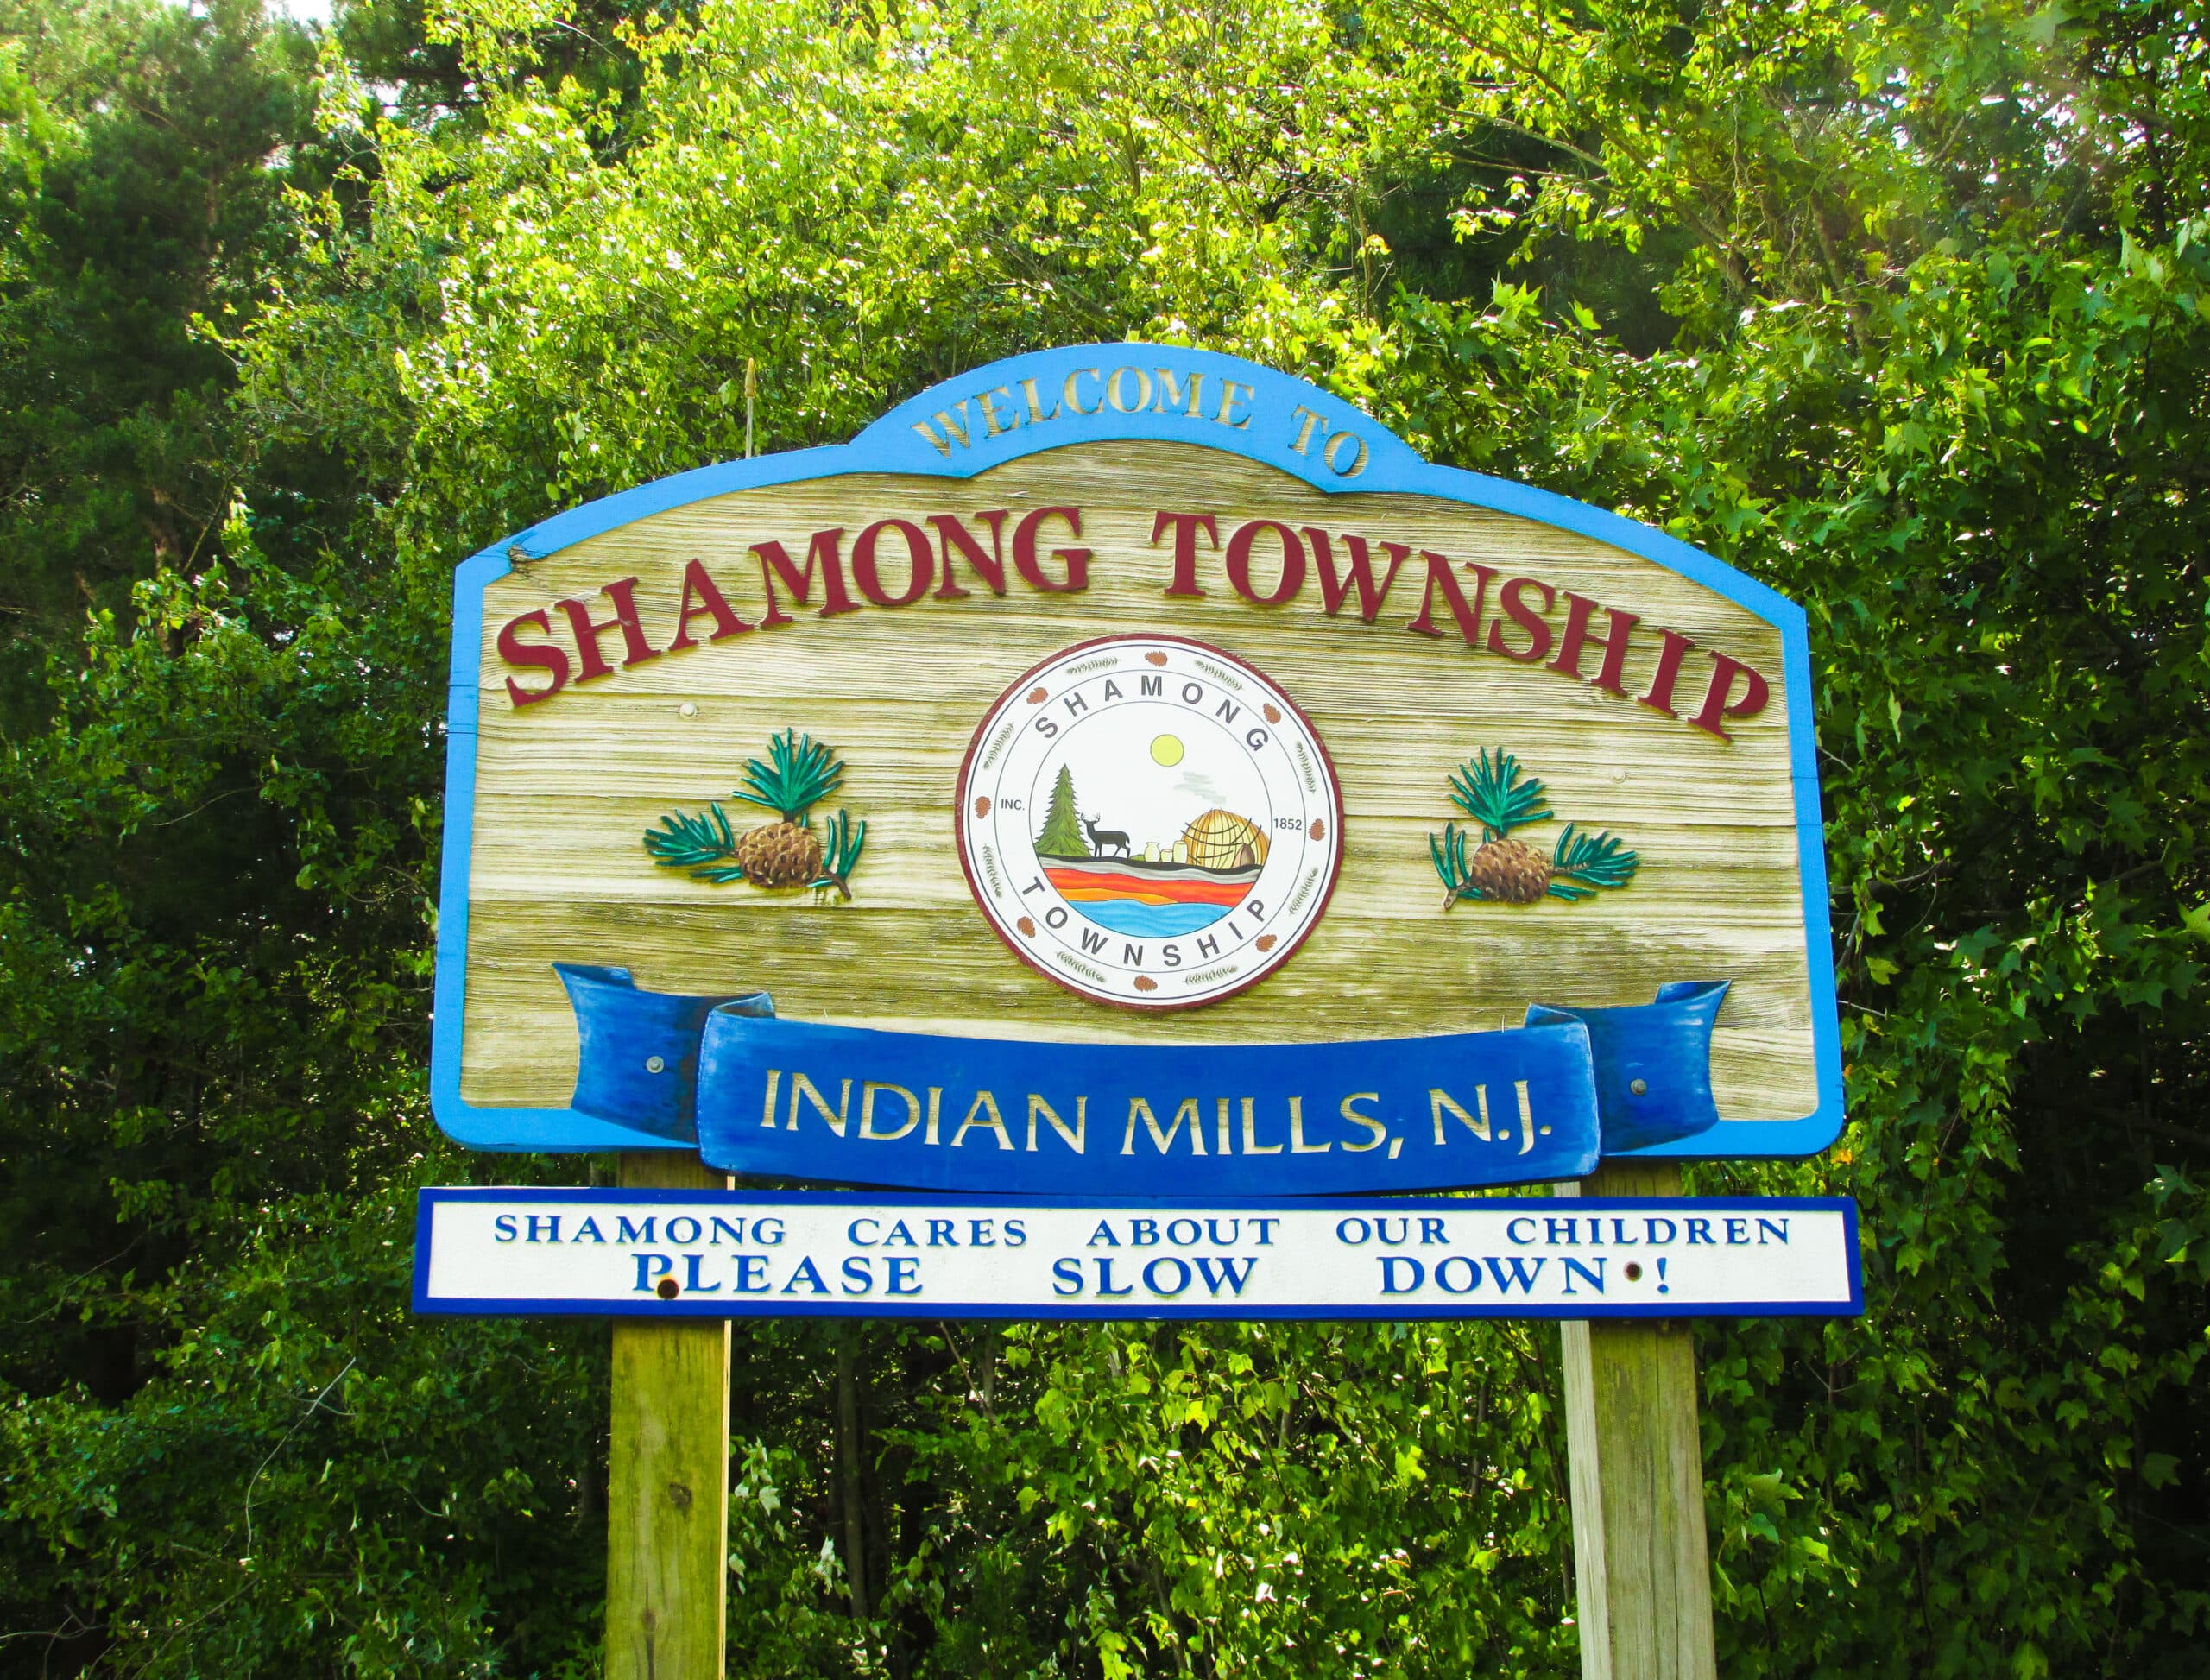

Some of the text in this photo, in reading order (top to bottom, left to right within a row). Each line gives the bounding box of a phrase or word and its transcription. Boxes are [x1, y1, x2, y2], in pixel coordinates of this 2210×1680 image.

[912, 366, 1368, 477] WELCOME TO
[497, 506, 1769, 742] SHAMONG TOWNSHIP
[1035, 675, 1268, 751] SHAMONG
[1001, 799, 1025, 811] INC.
[1273, 818, 1302, 831] 1852
[1022, 876, 1266, 966] TOWNSHIP
[760, 1070, 1551, 1159] INDIAN MILLS, N.J.
[494, 1215, 1790, 1247] SHAMONG CARES ABOUT OUR CHILDREN
[632, 1253, 923, 1295] PLEASE
[1052, 1257, 1259, 1296] SLOW
